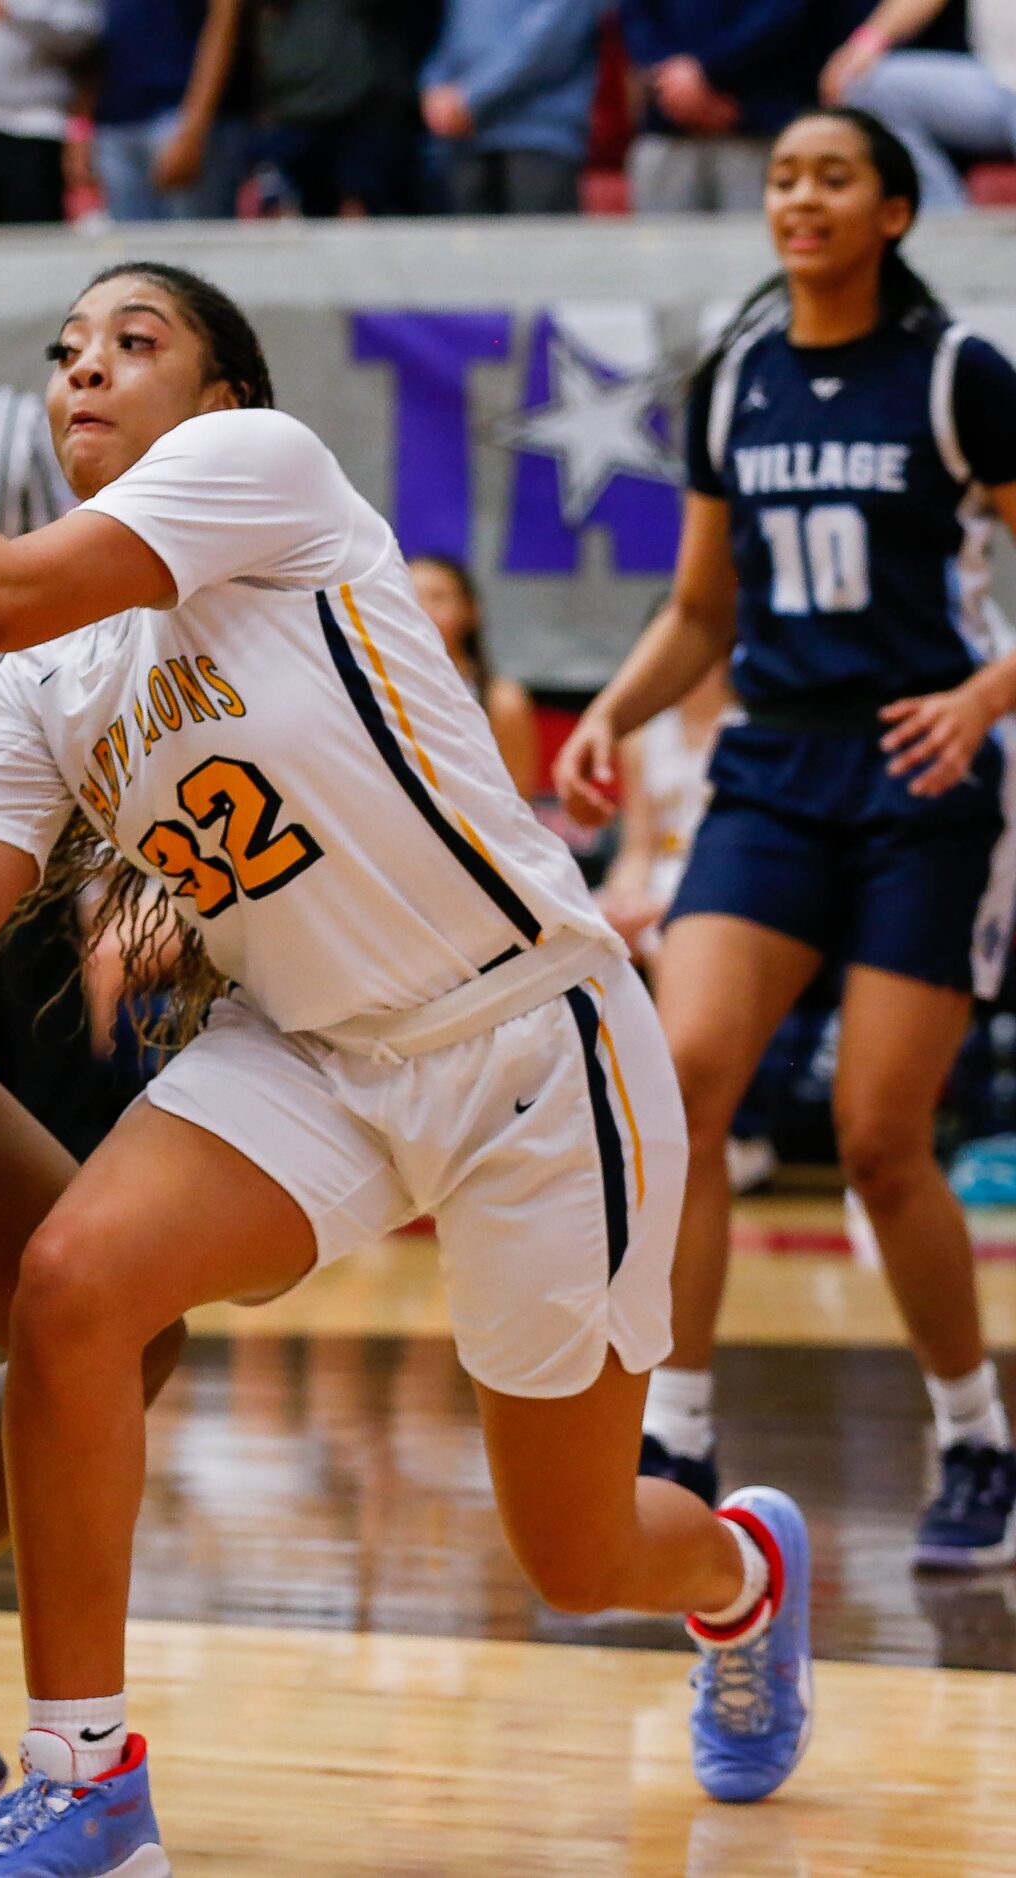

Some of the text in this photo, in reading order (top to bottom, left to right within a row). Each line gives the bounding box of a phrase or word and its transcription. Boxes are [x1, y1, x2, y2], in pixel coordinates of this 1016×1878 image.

[735, 441, 911, 496] VILLAGE
[758, 502, 872, 616] 10
[137, 755, 326, 919] 32
